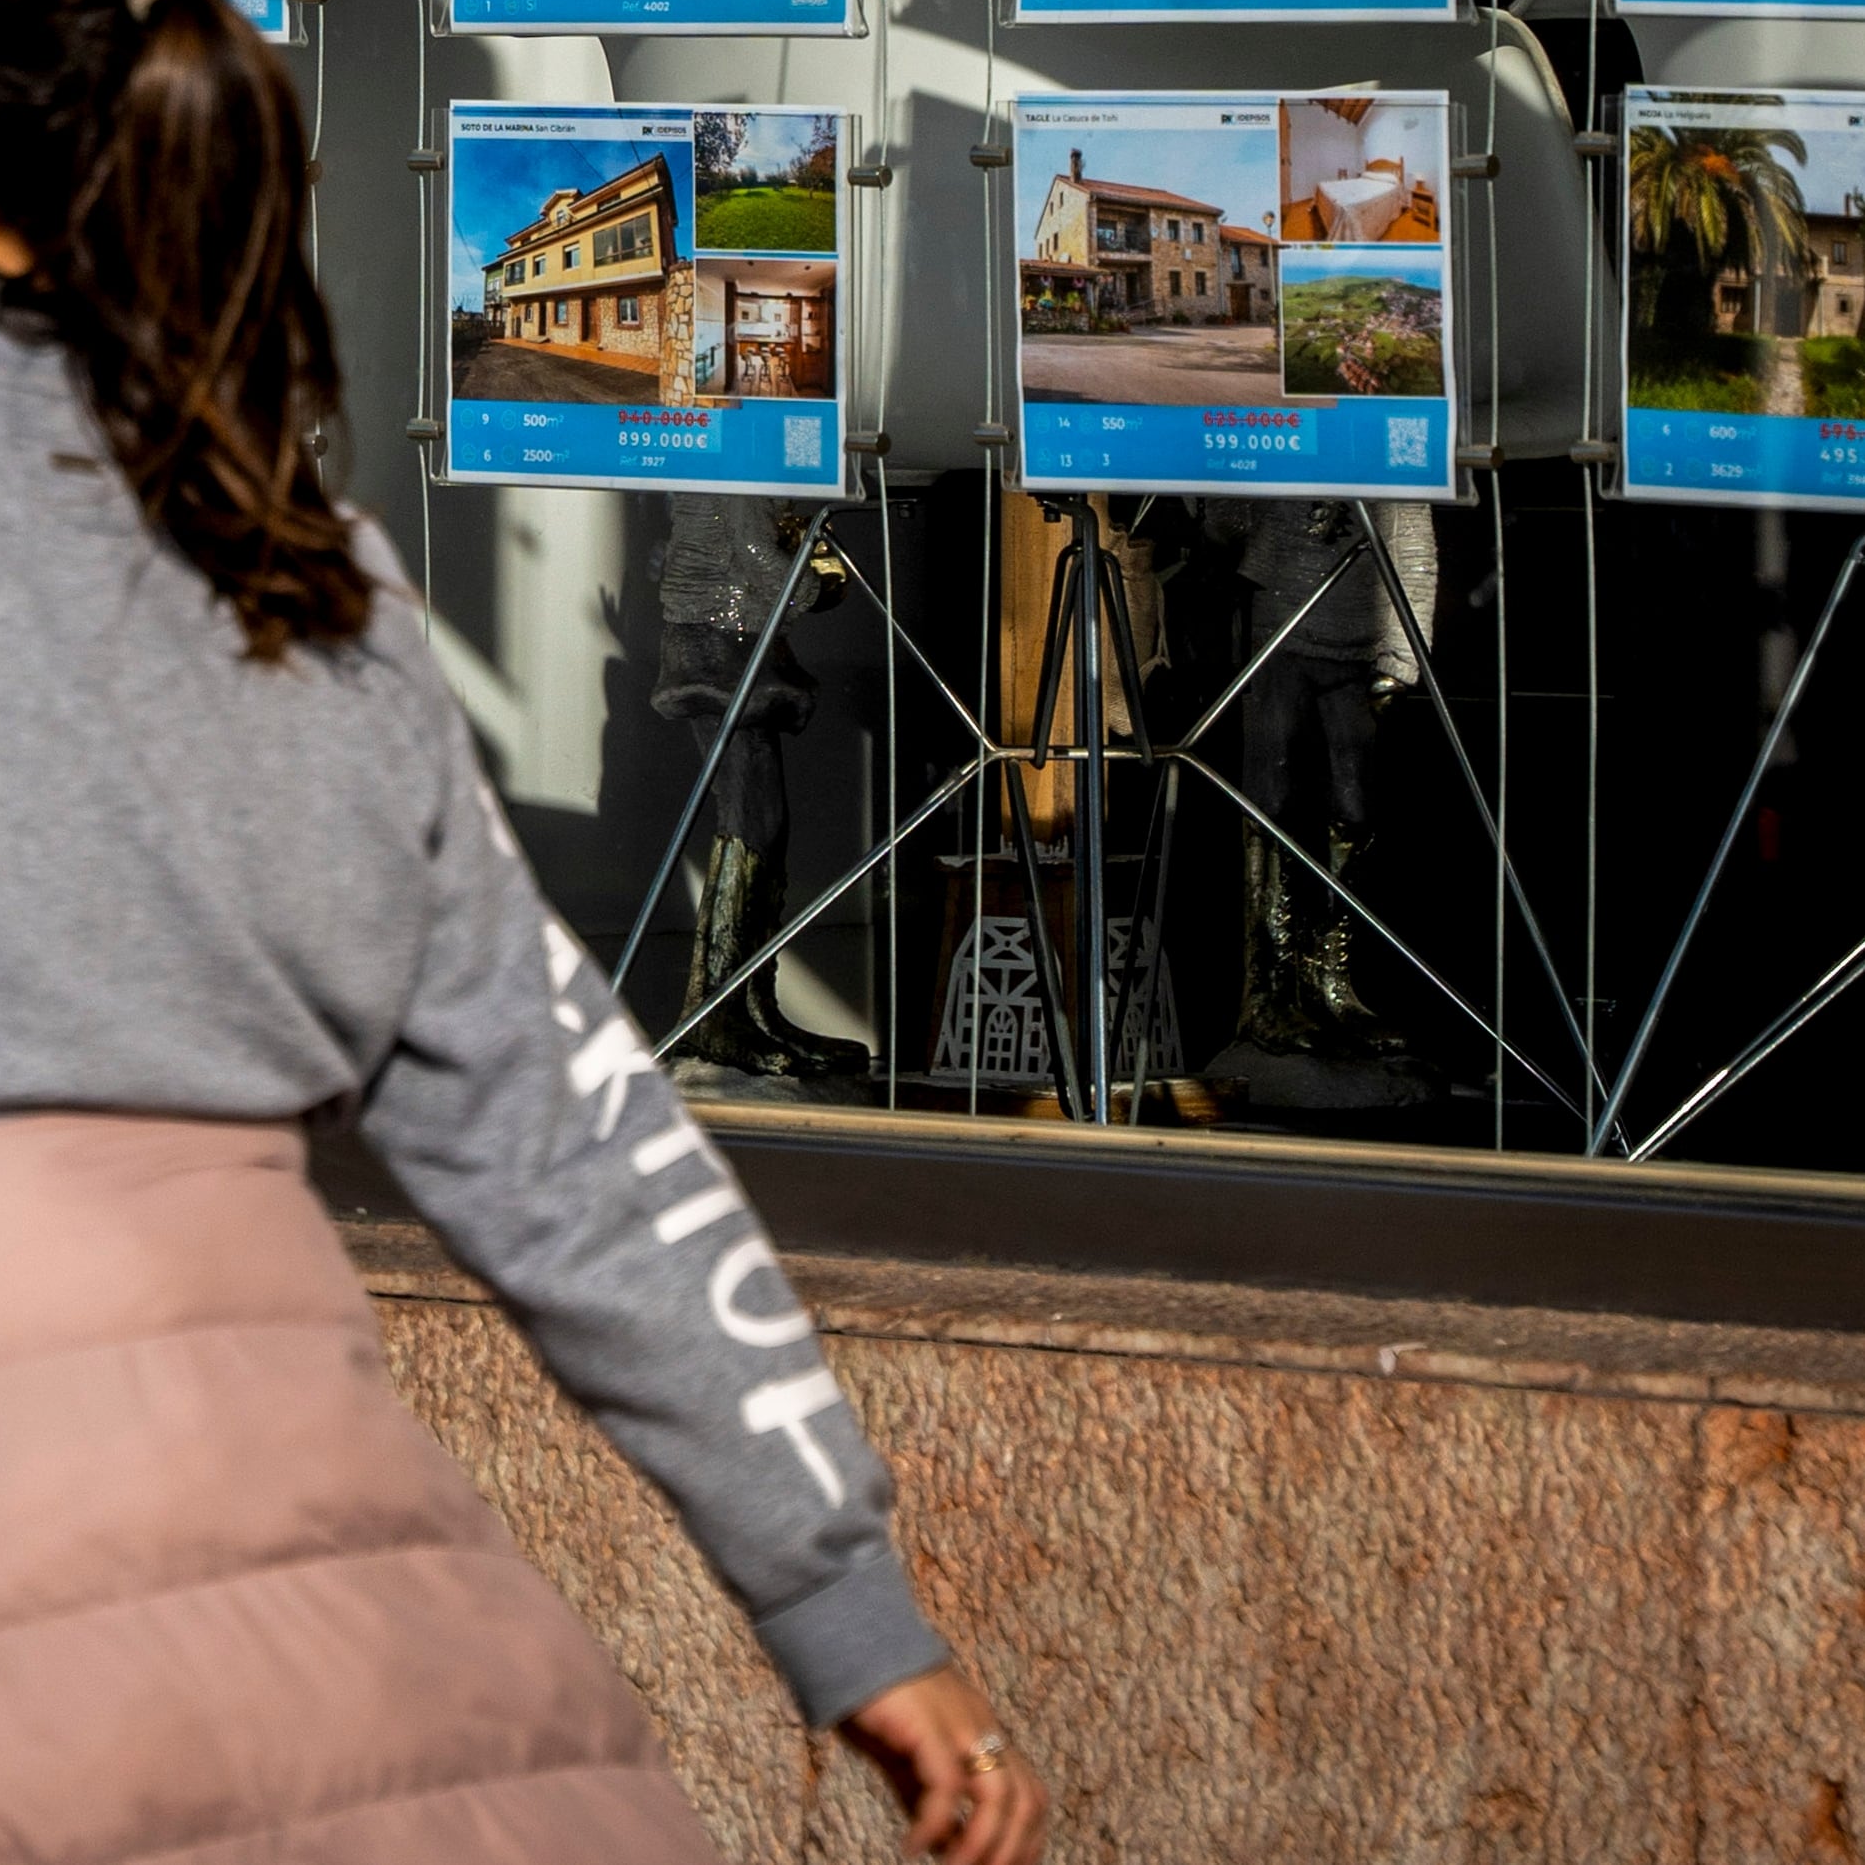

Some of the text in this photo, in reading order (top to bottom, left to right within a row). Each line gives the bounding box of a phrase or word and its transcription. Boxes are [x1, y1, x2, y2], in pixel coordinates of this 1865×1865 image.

[461, 123, 480, 133] SOTO
[481, 124, 493, 133] DE
[494, 124, 504, 133] LA
[618, 430, 708, 449] 899.000€
[1202, 433, 1301, 451] 599.000€
